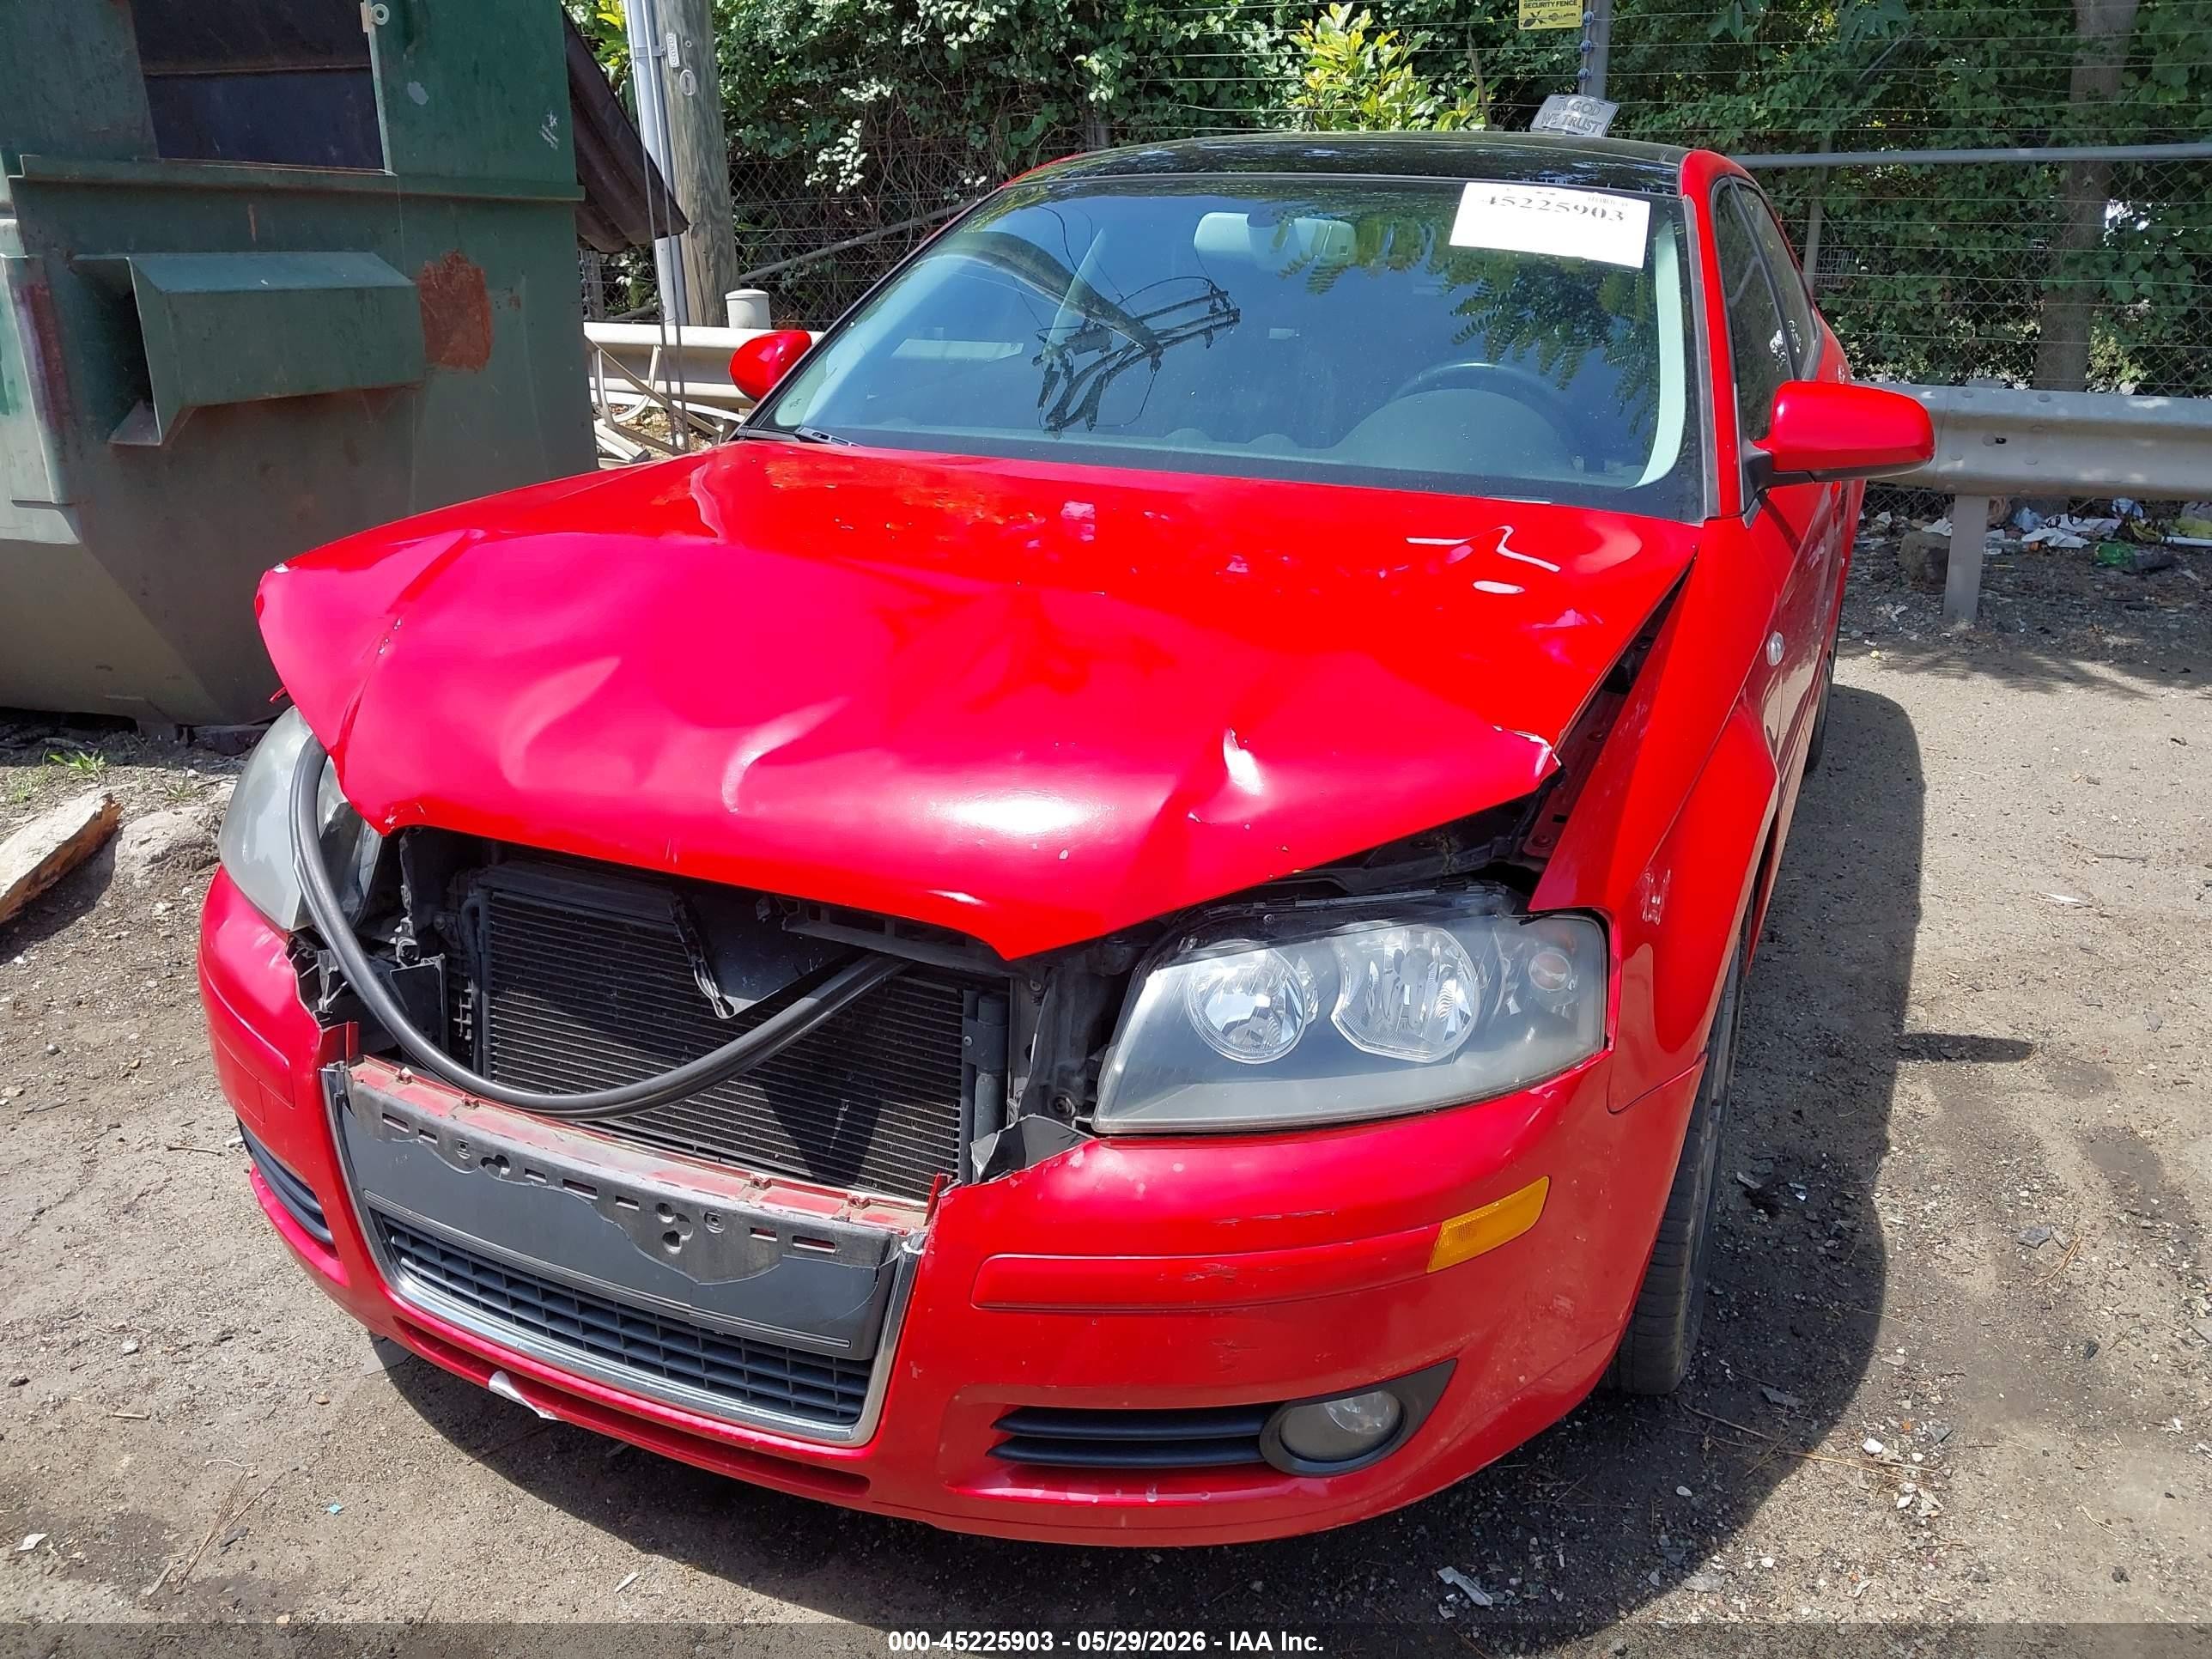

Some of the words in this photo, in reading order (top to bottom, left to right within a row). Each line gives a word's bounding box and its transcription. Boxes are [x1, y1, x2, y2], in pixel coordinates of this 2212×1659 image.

[1571, 100, 1601, 116] GOD
[1541, 112, 1560, 125] WE
[1562, 114, 1602, 133] TRUST
